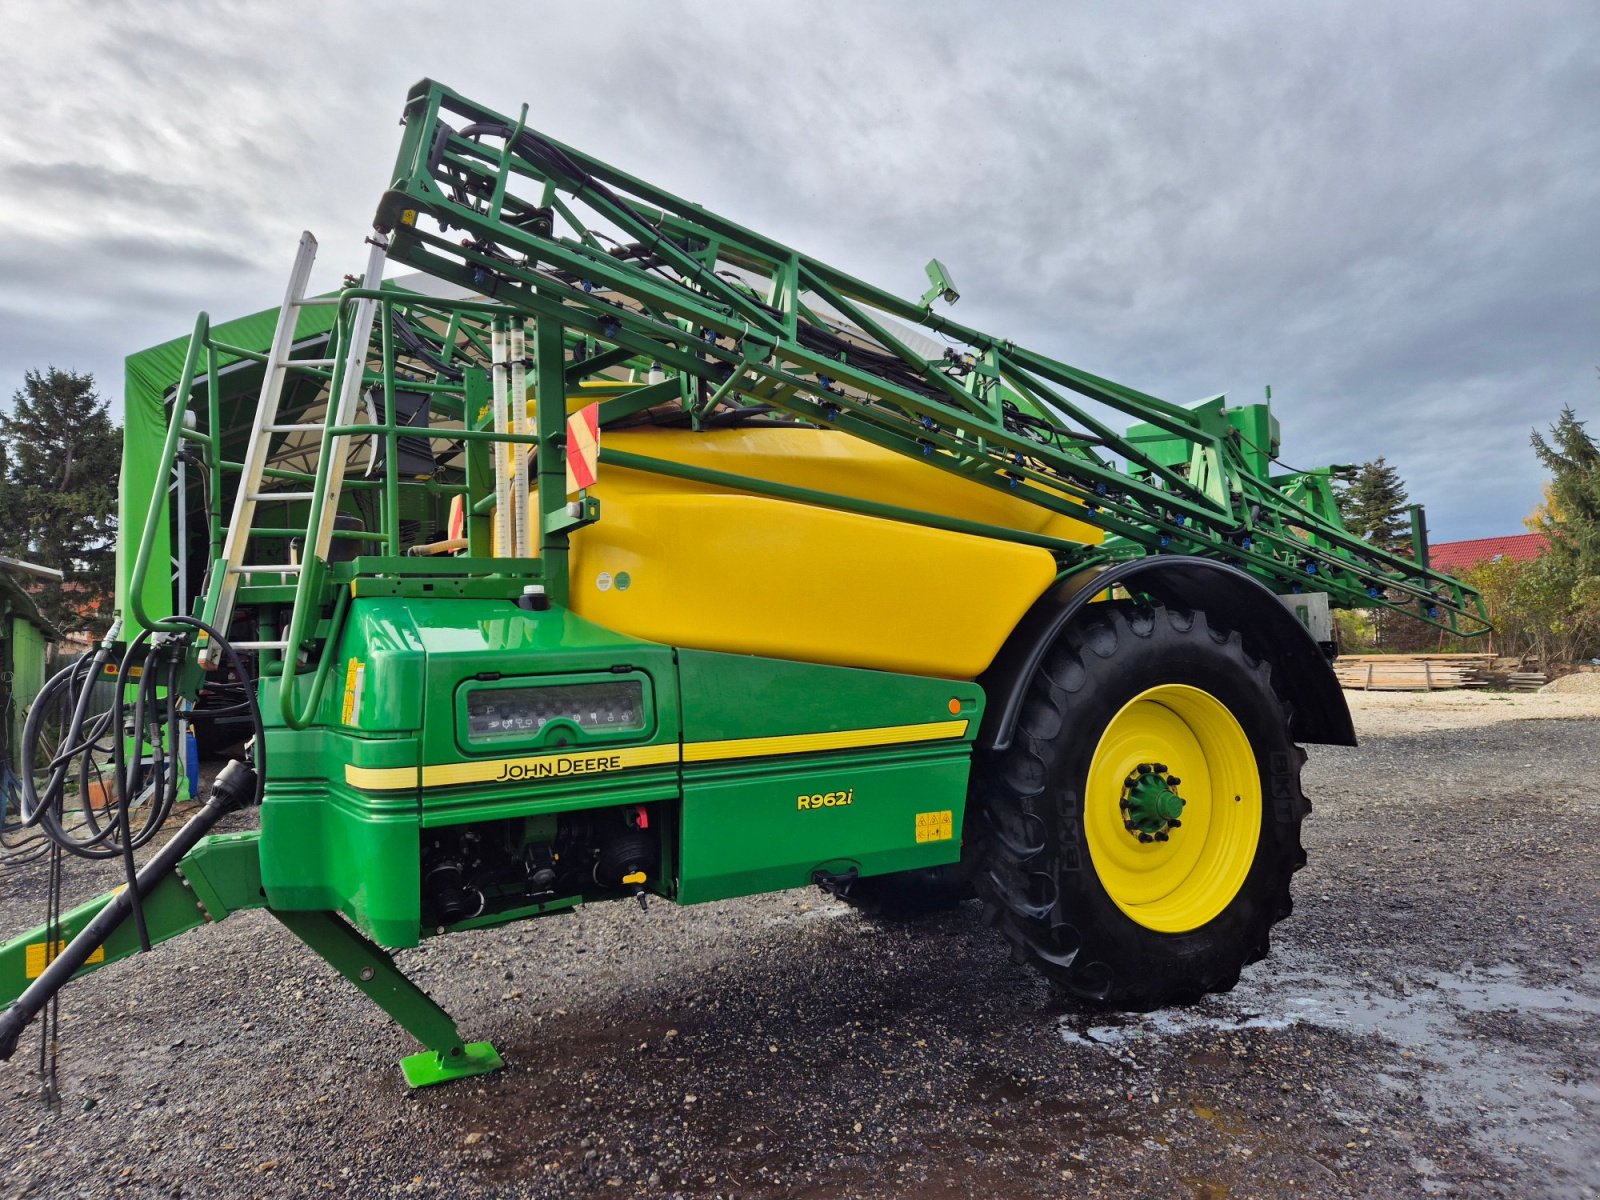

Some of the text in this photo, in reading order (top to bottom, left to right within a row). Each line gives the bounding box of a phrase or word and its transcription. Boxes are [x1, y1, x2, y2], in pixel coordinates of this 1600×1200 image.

[496, 755, 621, 780] JOHN DEERE
[1272, 753, 1294, 822] BKT
[797, 788, 854, 811] R962i
[1059, 791, 1081, 870] BKT
